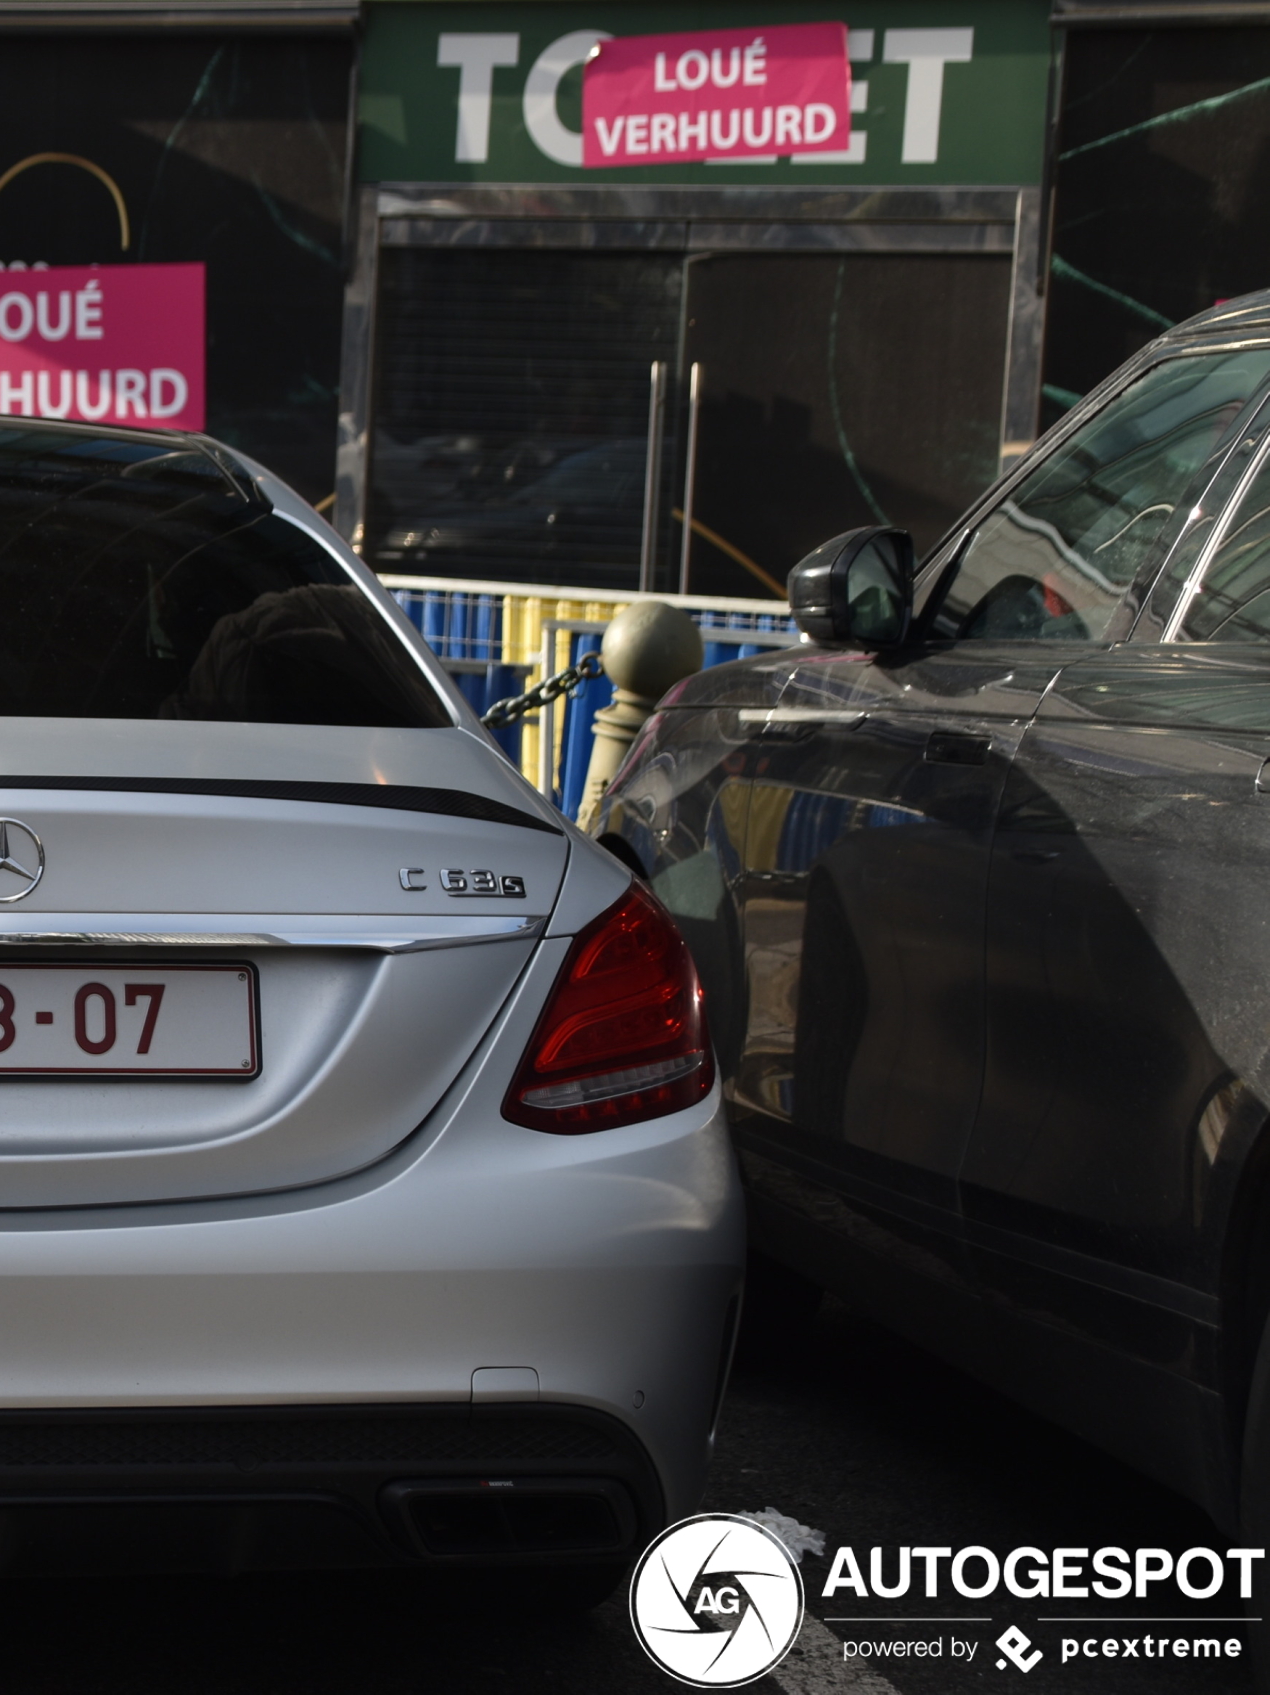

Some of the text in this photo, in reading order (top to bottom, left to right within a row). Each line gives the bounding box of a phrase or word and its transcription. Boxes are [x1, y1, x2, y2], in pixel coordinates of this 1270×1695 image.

[654, 38, 768, 92] LOUÉ
[594, 102, 837, 156] VERHUURD
[399, 868, 427, 891] C
